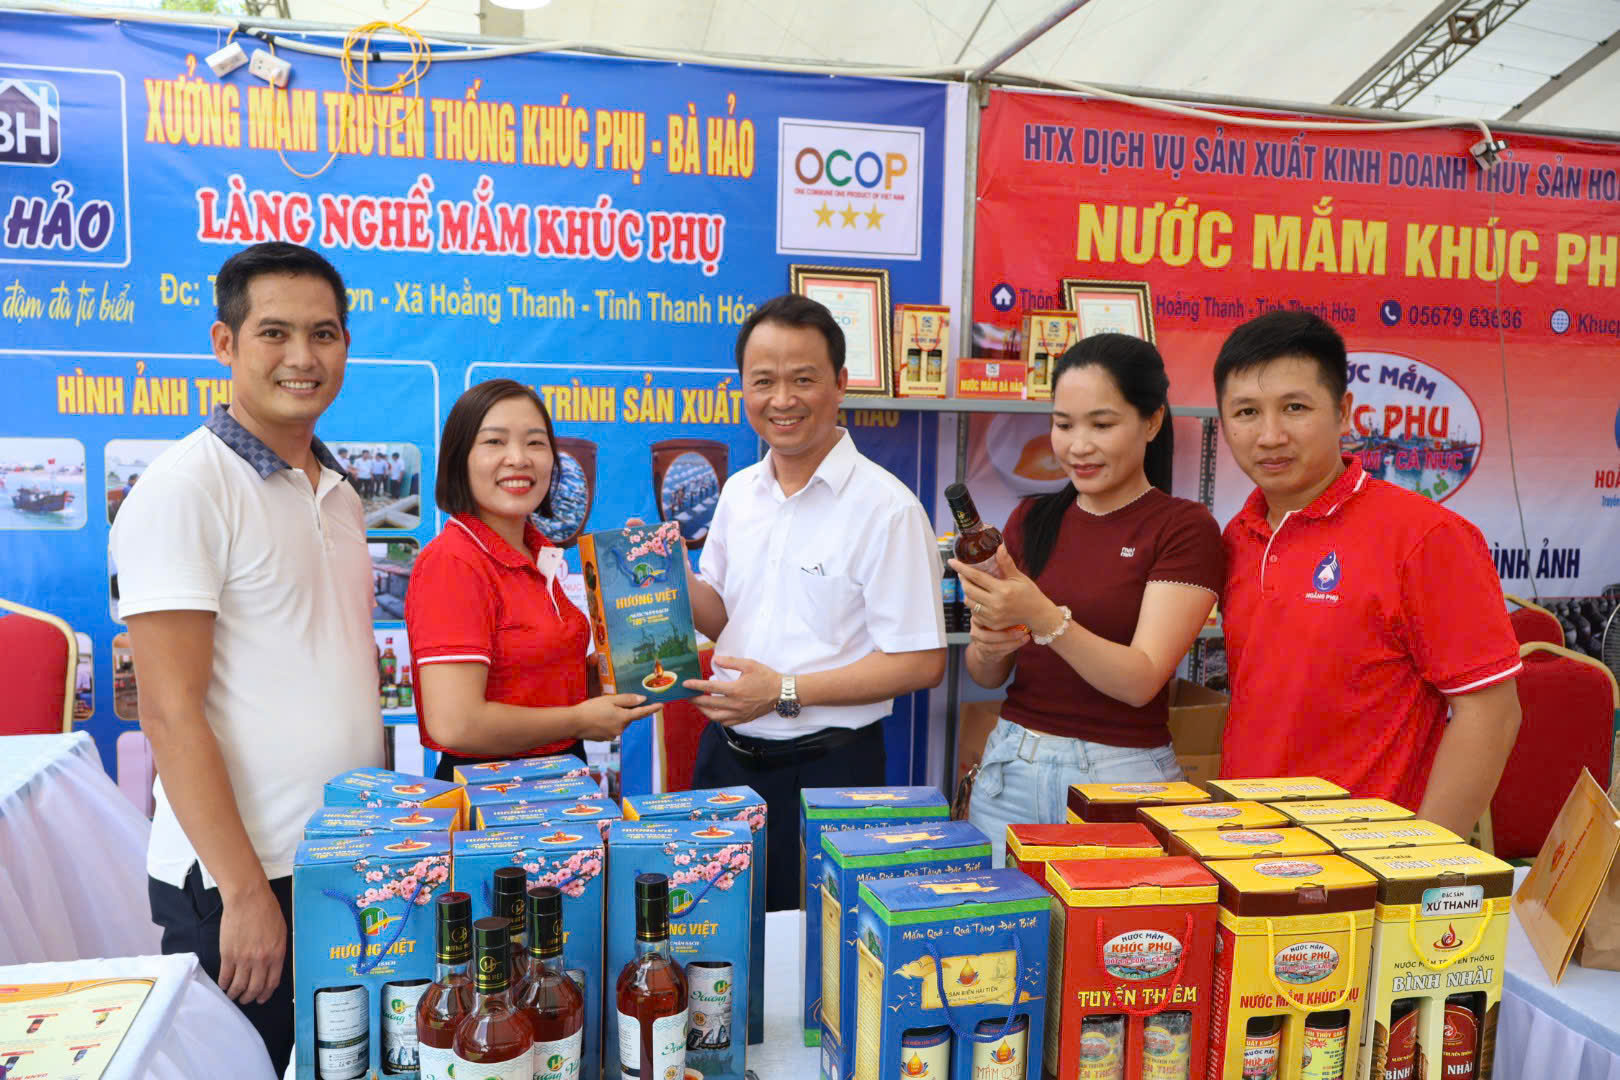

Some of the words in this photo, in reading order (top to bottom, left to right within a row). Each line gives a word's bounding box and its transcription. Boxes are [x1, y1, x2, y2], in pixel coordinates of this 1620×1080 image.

[144, 54, 241, 148] XƯỞNG
[430, 78, 516, 164] THỐNG
[521, 93, 590, 168] KHÚC
[595, 110, 646, 184] PHỤ
[667, 102, 701, 174] BÀ
[706, 92, 755, 178] HẢO
[795, 147, 908, 190] OCOP
[1024, 124, 1075, 163] HTX
[1083, 129, 1145, 174] DỊCH
[1153, 134, 1186, 179] VỤ
[1194, 127, 1245, 175] SẢN
[1253, 132, 1316, 179] XUẤT
[1323, 147, 1381, 184] KINH
[1388, 152, 1467, 190] DOANH
[1536, 155, 1582, 199] SẢN
[6, 182, 113, 250] HẢO
[199, 175, 314, 243] LÀNG
[321, 175, 434, 250] NGHỀ
[437, 174, 529, 255] MẮM
[535, 194, 644, 260] KHÚC
[647, 211, 726, 276] PHỤ
[1076, 197, 1233, 268] NƯỚC
[1253, 196, 1388, 276] MẮM
[1405, 216, 1540, 283] KHÚC
[3, 279, 45, 324] đậm
[49, 281, 74, 320] đà
[98, 281, 136, 324] biển
[160, 274, 200, 305] Đc:
[395, 282, 423, 313] Xã
[430, 278, 502, 324] Hoằng
[507, 286, 575, 319] Thanh
[595, 289, 641, 321] Tỉnh
[650, 292, 713, 324] Thanh
[1204, 297, 1245, 318] Thanh
[1331, 303, 1356, 322] Hóa
[1409, 305, 1463, 326] 05679
[1469, 308, 1522, 329] 63636
[57, 368, 124, 415] HÌNH
[132, 361, 189, 415] ẢNH
[1379, 364, 1437, 401] MẮM
[542, 377, 616, 421] TRÌNH
[624, 373, 673, 423] SẢN
[680, 378, 743, 424] XUẤT
[1383, 405, 1450, 449] PHỤ
[1395, 446, 1421, 471] CÁ
[1535, 537, 1581, 579] ẢNH
[615, 594, 654, 609] HƯƠNG
[655, 587, 678, 604] VIỆT
[1426, 900, 1445, 912] XỨ
[1445, 899, 1479, 910] THANH
[690, 920, 718, 938] VIỆT
[903, 930, 924, 941] Mắm
[927, 928, 944, 939] Quê
[953, 924, 972, 938] Quà
[974, 923, 996, 937] Tặng
[1019, 916, 1038, 930] Biệt
[1112, 942, 1144, 953] KHÚC
[1394, 960, 1418, 969] NƯỚC
[1470, 954, 1495, 962] THỐNG
[1142, 983, 1198, 1005] THÊM
[1392, 972, 1442, 993] BÌNH
[1446, 965, 1494, 988] NHÀI
[1240, 993, 1273, 1009] NƯỚC
[1306, 987, 1337, 1006] KHÚC
[1447, 1060, 1473, 1075] NHÀI
